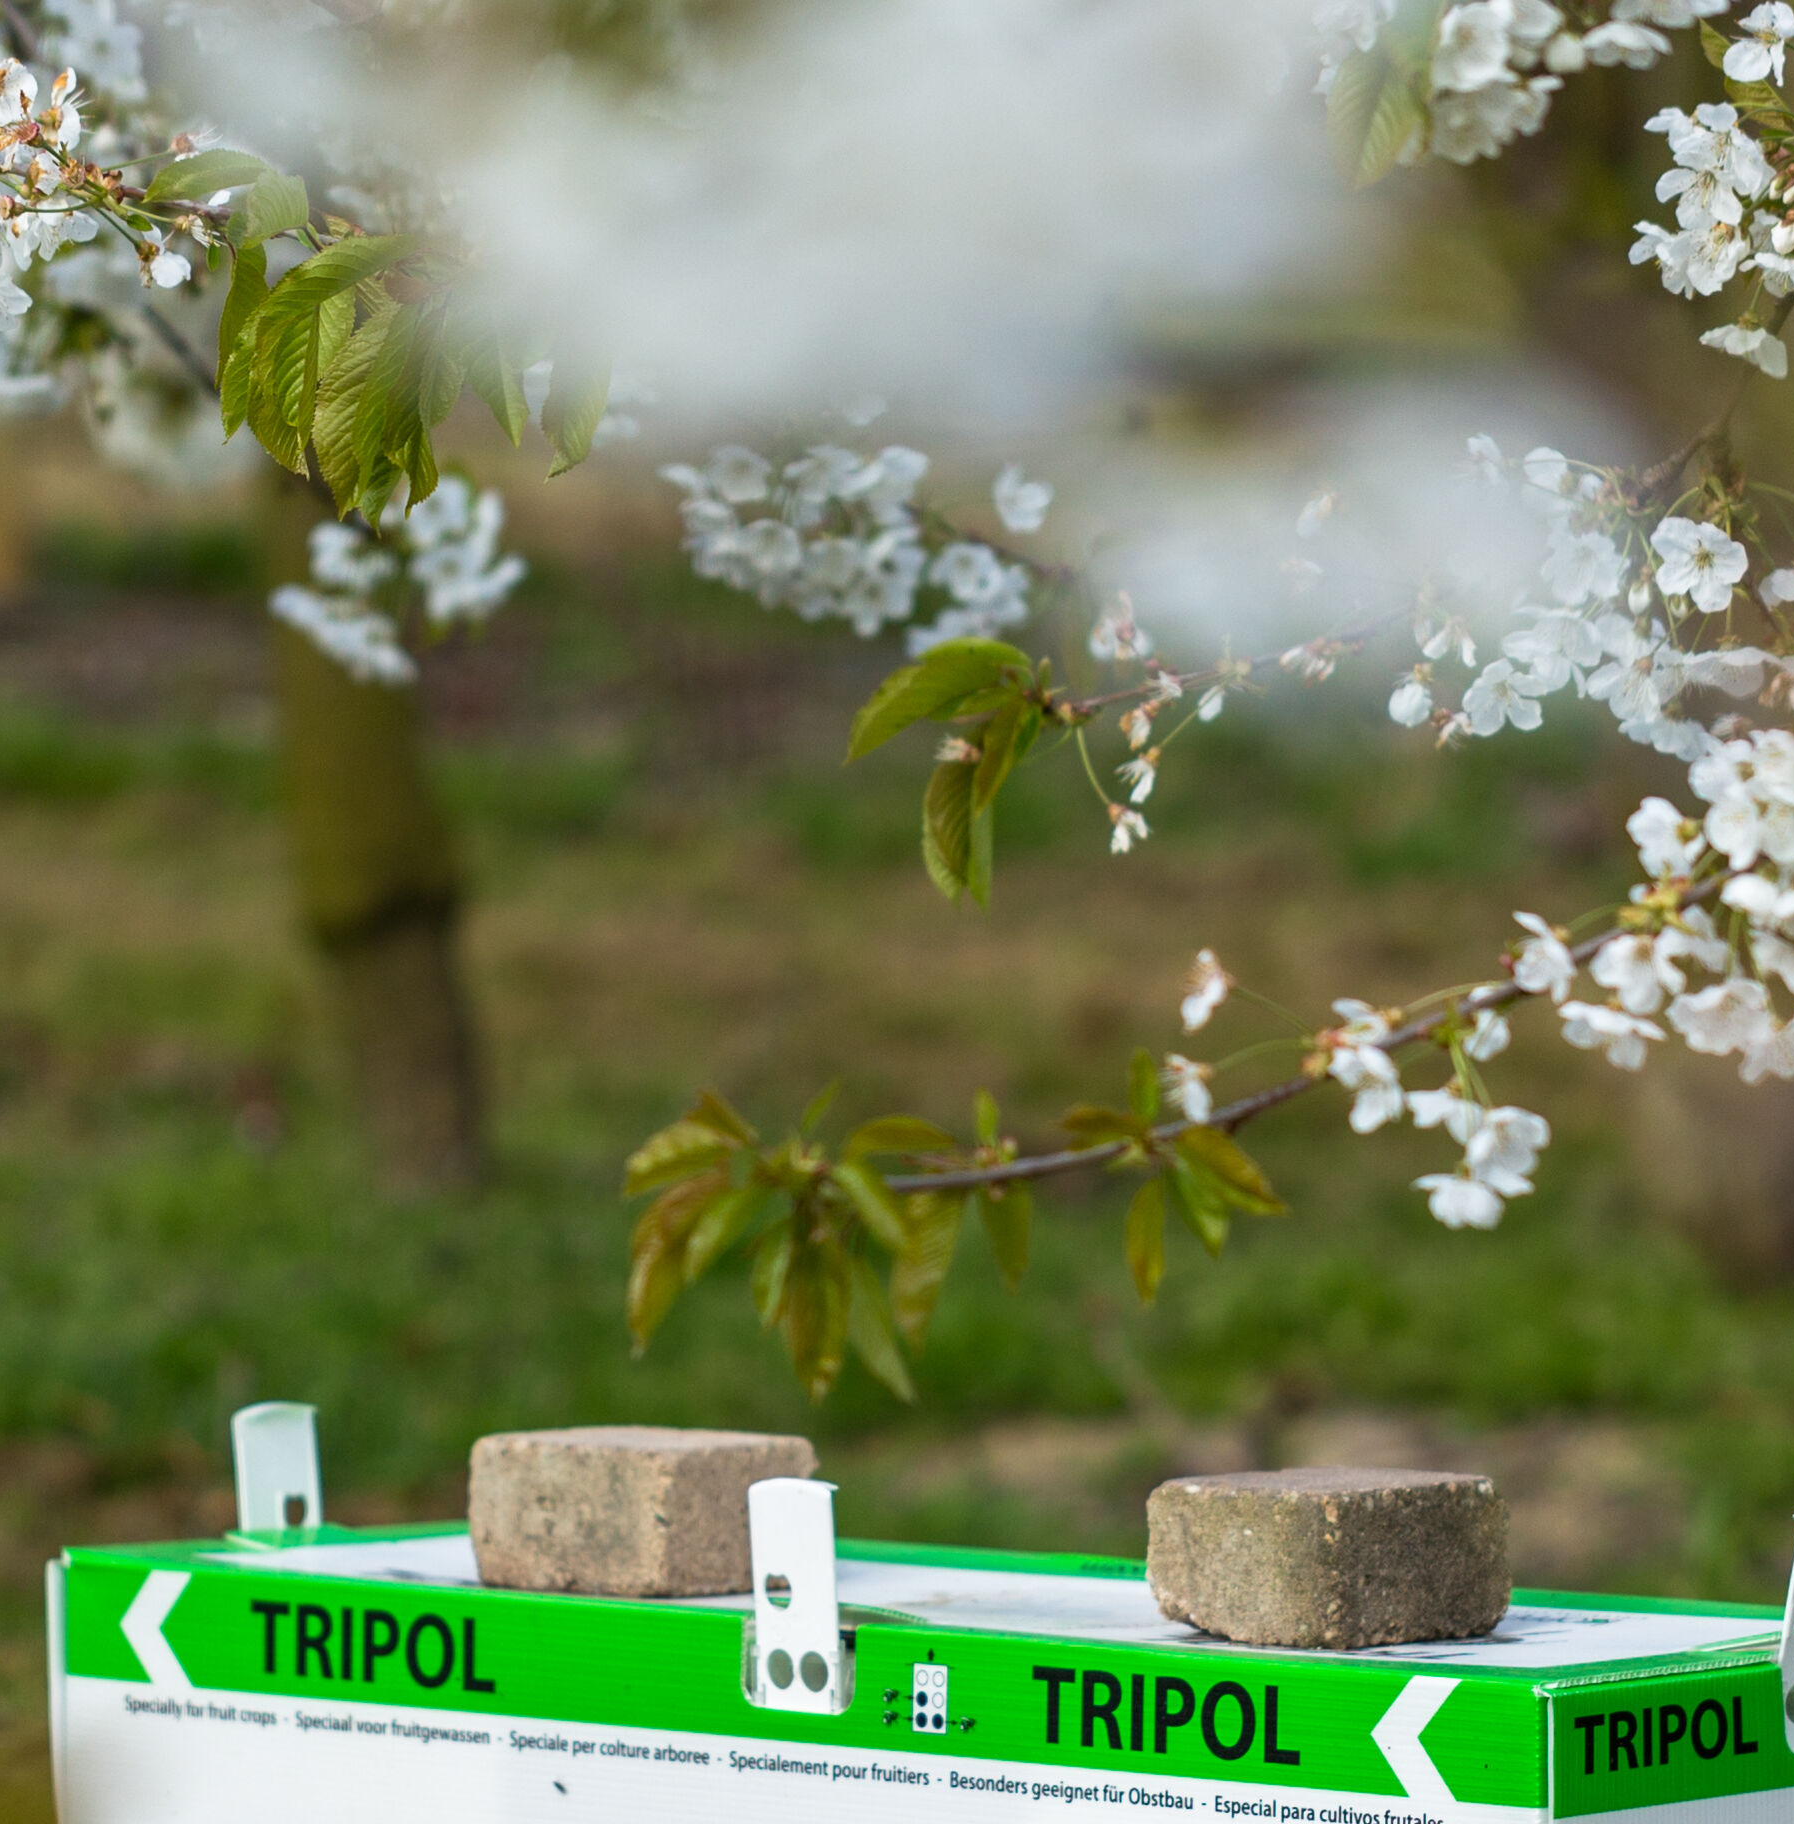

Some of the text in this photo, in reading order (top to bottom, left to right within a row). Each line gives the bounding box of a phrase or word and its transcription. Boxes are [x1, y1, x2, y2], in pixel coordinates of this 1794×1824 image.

[250, 1600, 496, 1693] TRIPOL
[124, 1695, 278, 1726] Specially for fruit crops
[295, 1711, 490, 1745] Speciaal voor fruitgewassen
[1032, 1665, 1301, 1766] TRIPOL
[509, 1730, 711, 1766] Speciale per colture arboree
[1574, 1696, 1759, 1775] TRIPOL
[729, 1751, 930, 1786] Specialement pour fruitiers
[949, 1771, 1195, 1811] Besonders geeignet für Obstbau
[1214, 1795, 1277, 1819] Especial
[1280, 1804, 1316, 1824] para
